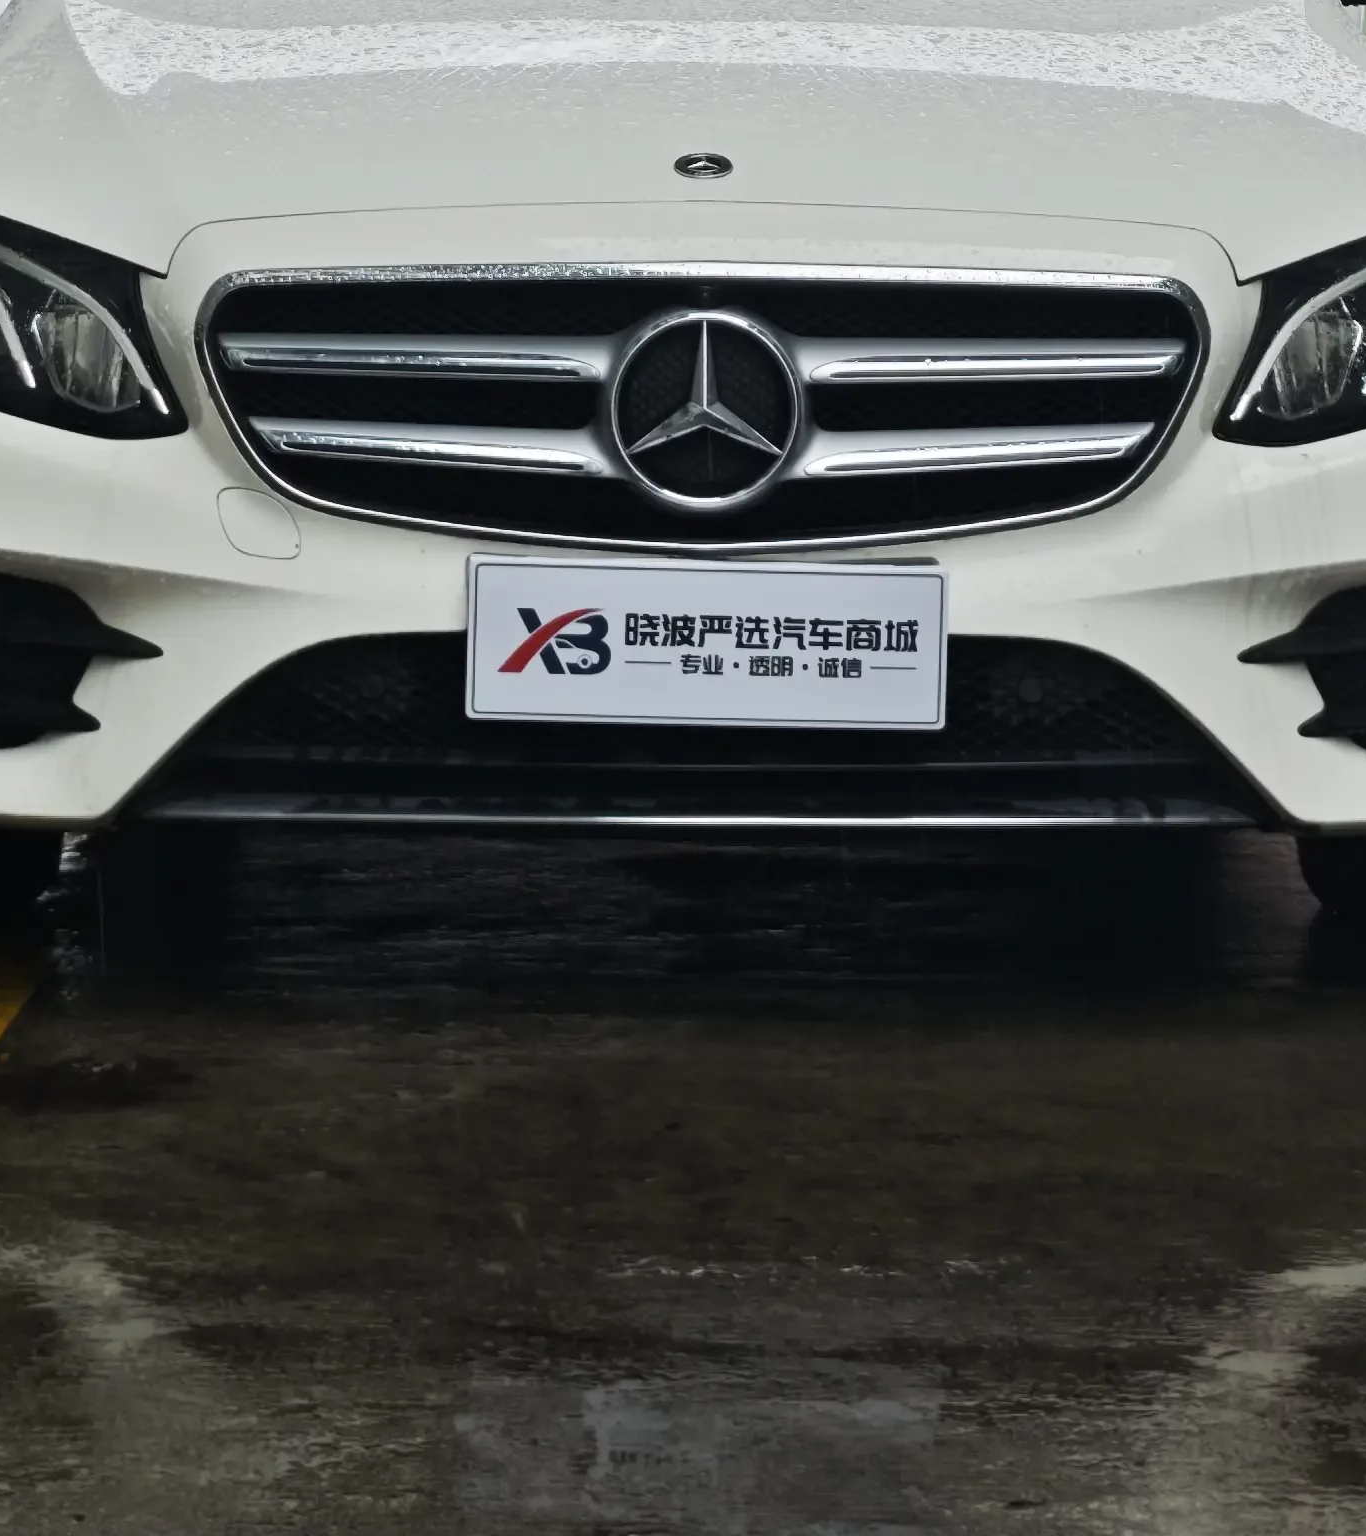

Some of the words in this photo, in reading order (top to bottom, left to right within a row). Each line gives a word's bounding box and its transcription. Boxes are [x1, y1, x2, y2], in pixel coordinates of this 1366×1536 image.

[624, 613, 919, 653] 晓波严选汽车商城
